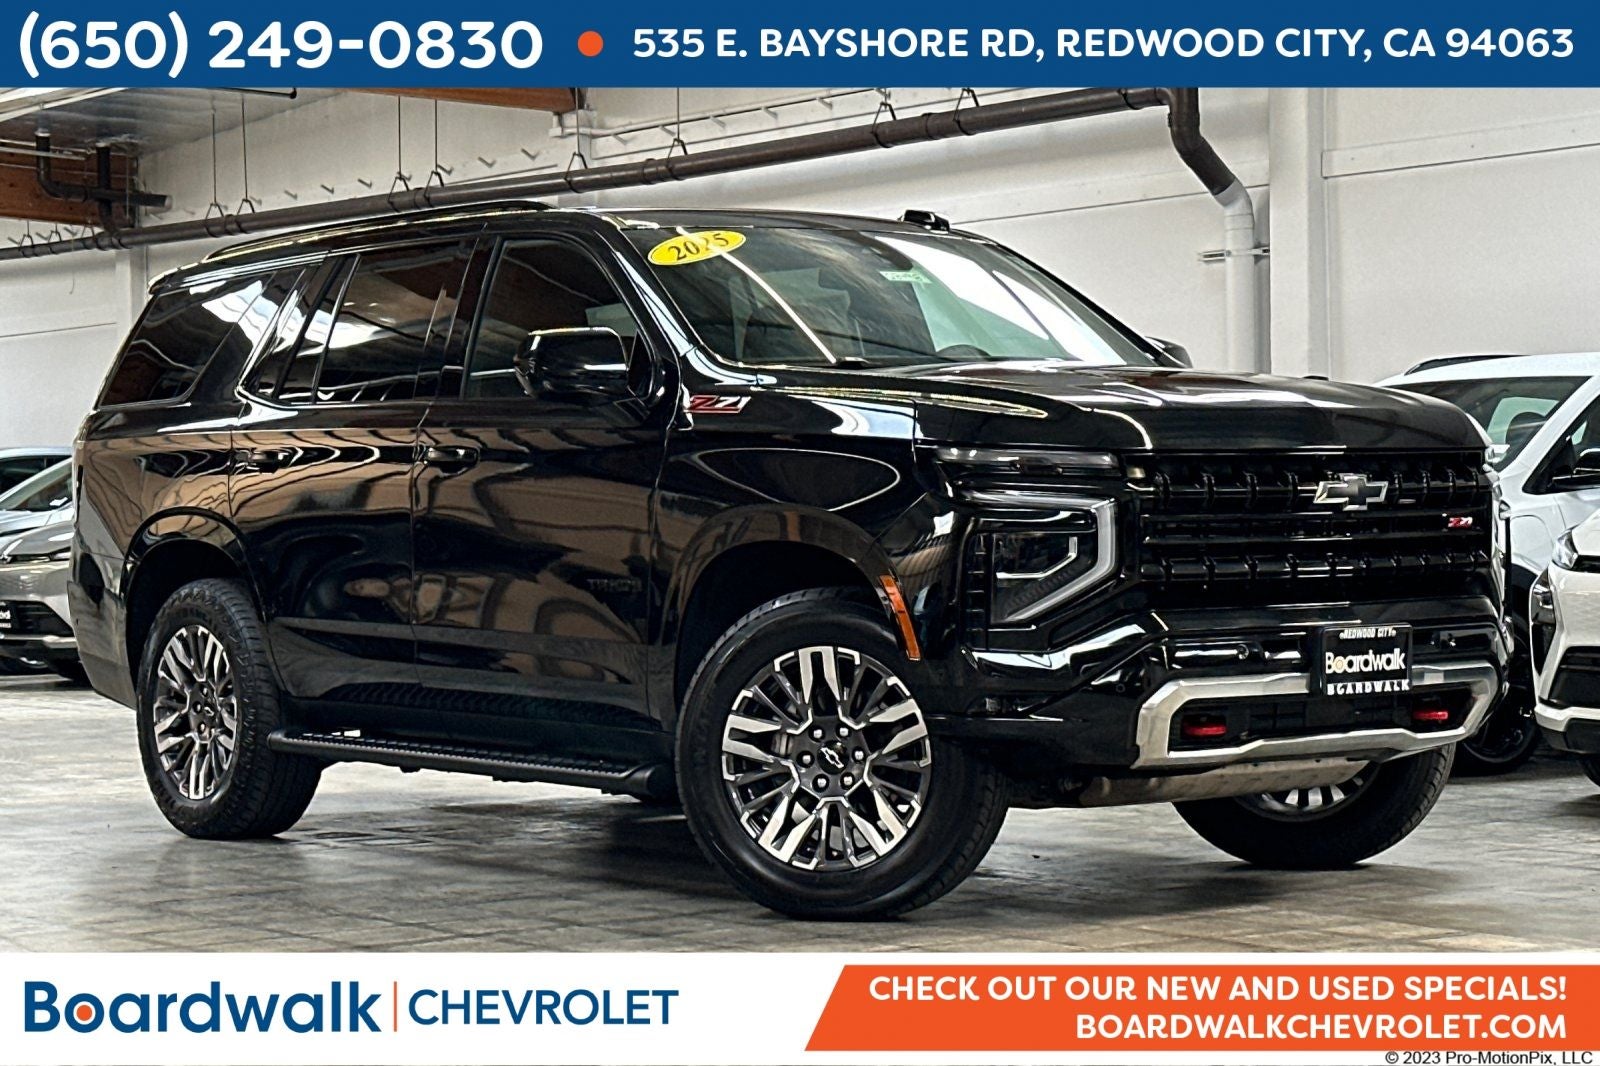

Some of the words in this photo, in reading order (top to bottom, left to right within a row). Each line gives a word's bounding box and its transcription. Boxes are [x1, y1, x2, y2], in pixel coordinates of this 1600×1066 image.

[667, 232, 729, 261] 2025
[684, 394, 752, 414] Z71
[1343, 627, 1376, 639] REDWOOD
[1325, 647, 1406, 675] Boardwalk
[1327, 679, 1410, 696] BOARDWALK
